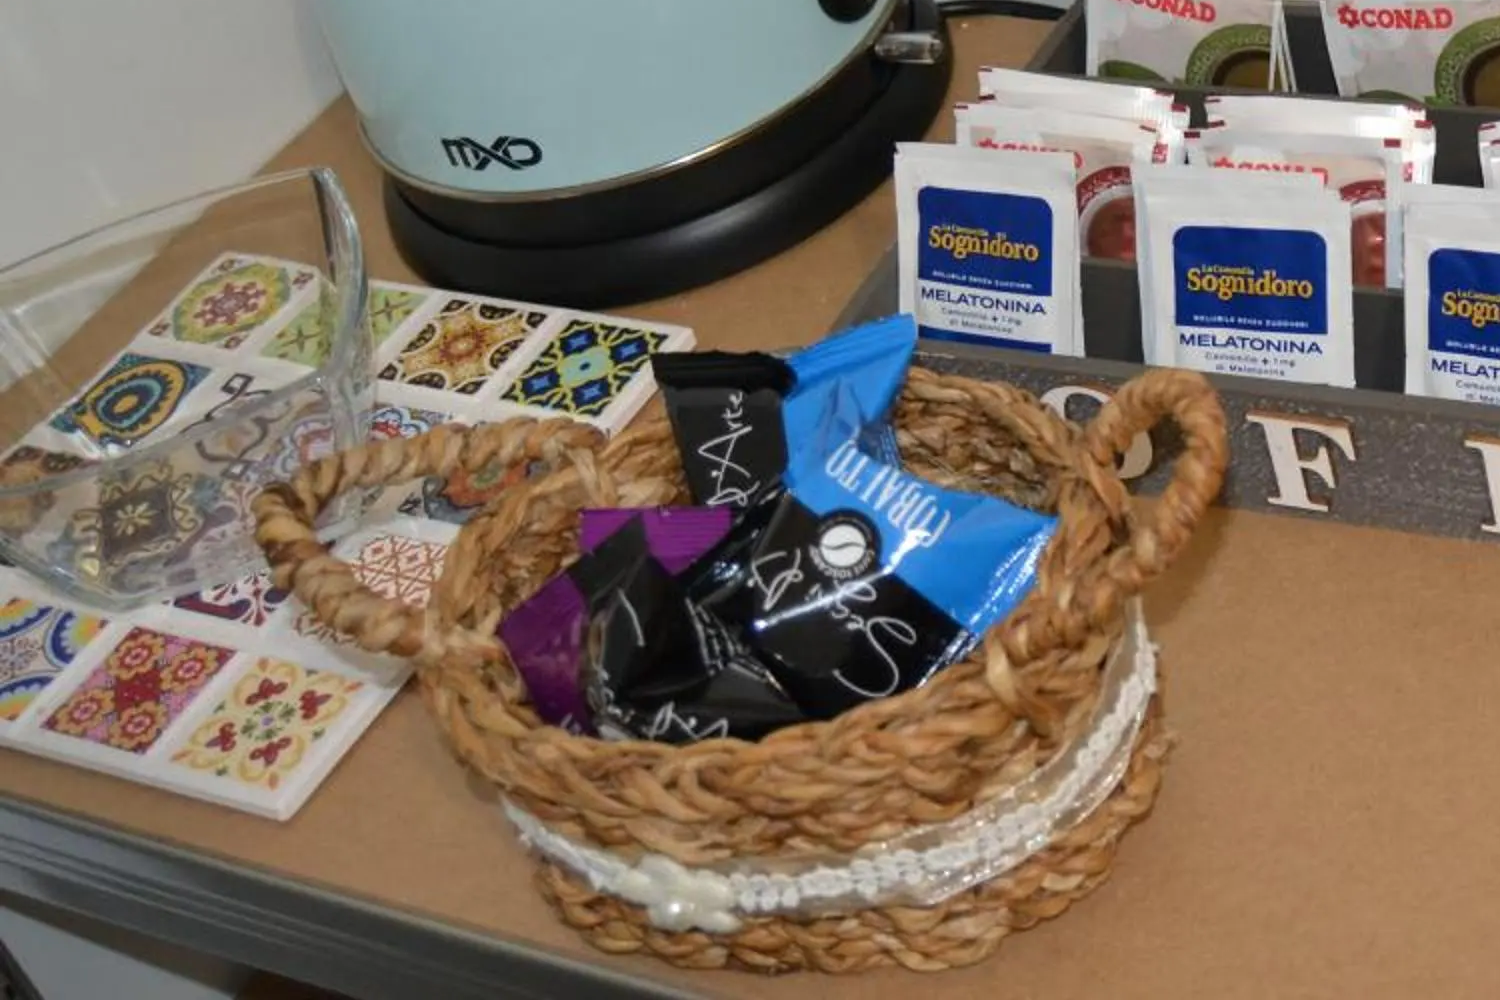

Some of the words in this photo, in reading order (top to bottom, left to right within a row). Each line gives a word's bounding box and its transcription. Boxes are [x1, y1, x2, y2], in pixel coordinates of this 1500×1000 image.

[1360, 6, 1453, 30] CONAD
[921, 286, 1047, 315] MELATONINA
[1179, 333, 1323, 354] MELATONINA
